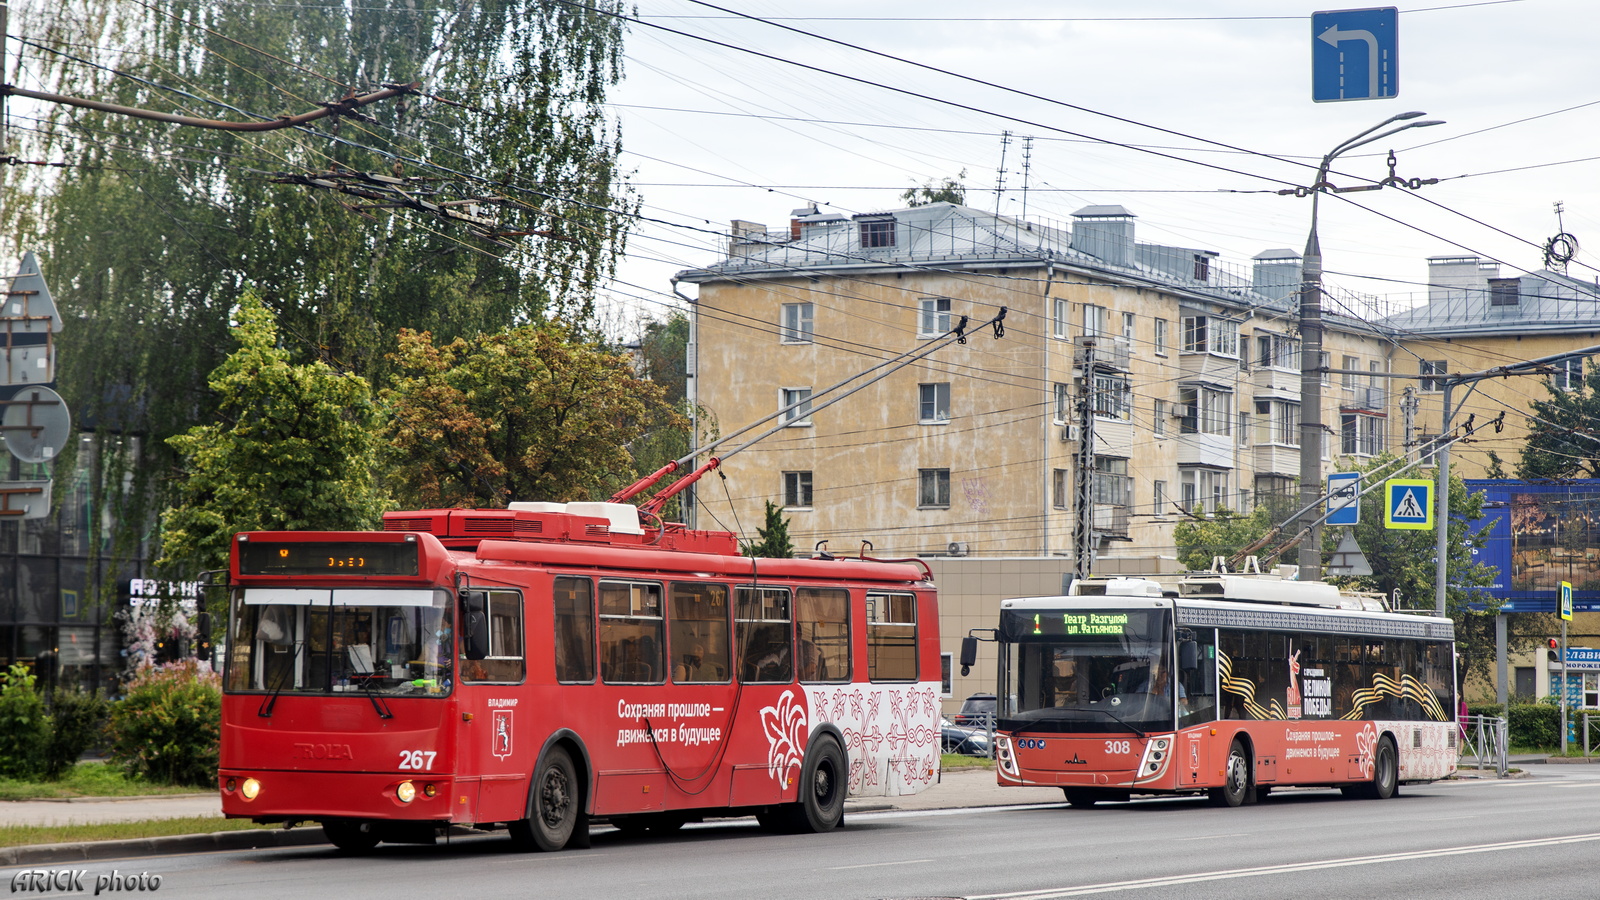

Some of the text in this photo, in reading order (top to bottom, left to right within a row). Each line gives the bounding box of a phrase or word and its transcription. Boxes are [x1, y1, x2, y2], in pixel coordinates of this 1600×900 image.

[711, 590, 726, 607] 267
[1033, 613, 1042, 634] 1
[1063, 613, 1128, 625] Театр Разгуляй
[1303, 677, 1332, 697] ВЕЛИКОЙ
[488, 698, 519, 708] ВЛАДИМИР
[617, 698, 666, 723] Сохраняя
[667, 702, 711, 722] прошлое
[1303, 697, 1332, 718] ПОБЕДЫ!
[670, 728, 677, 742] в
[679, 722, 721, 747] будущее
[1285, 728, 1310, 744] Сохраняя
[1311, 731, 1334, 744] прошлое
[1104, 740, 1131, 754] 308
[1285, 747, 1312, 760] движемся
[1317, 744, 1340, 760] будущее
[398, 749, 438, 771] 267
